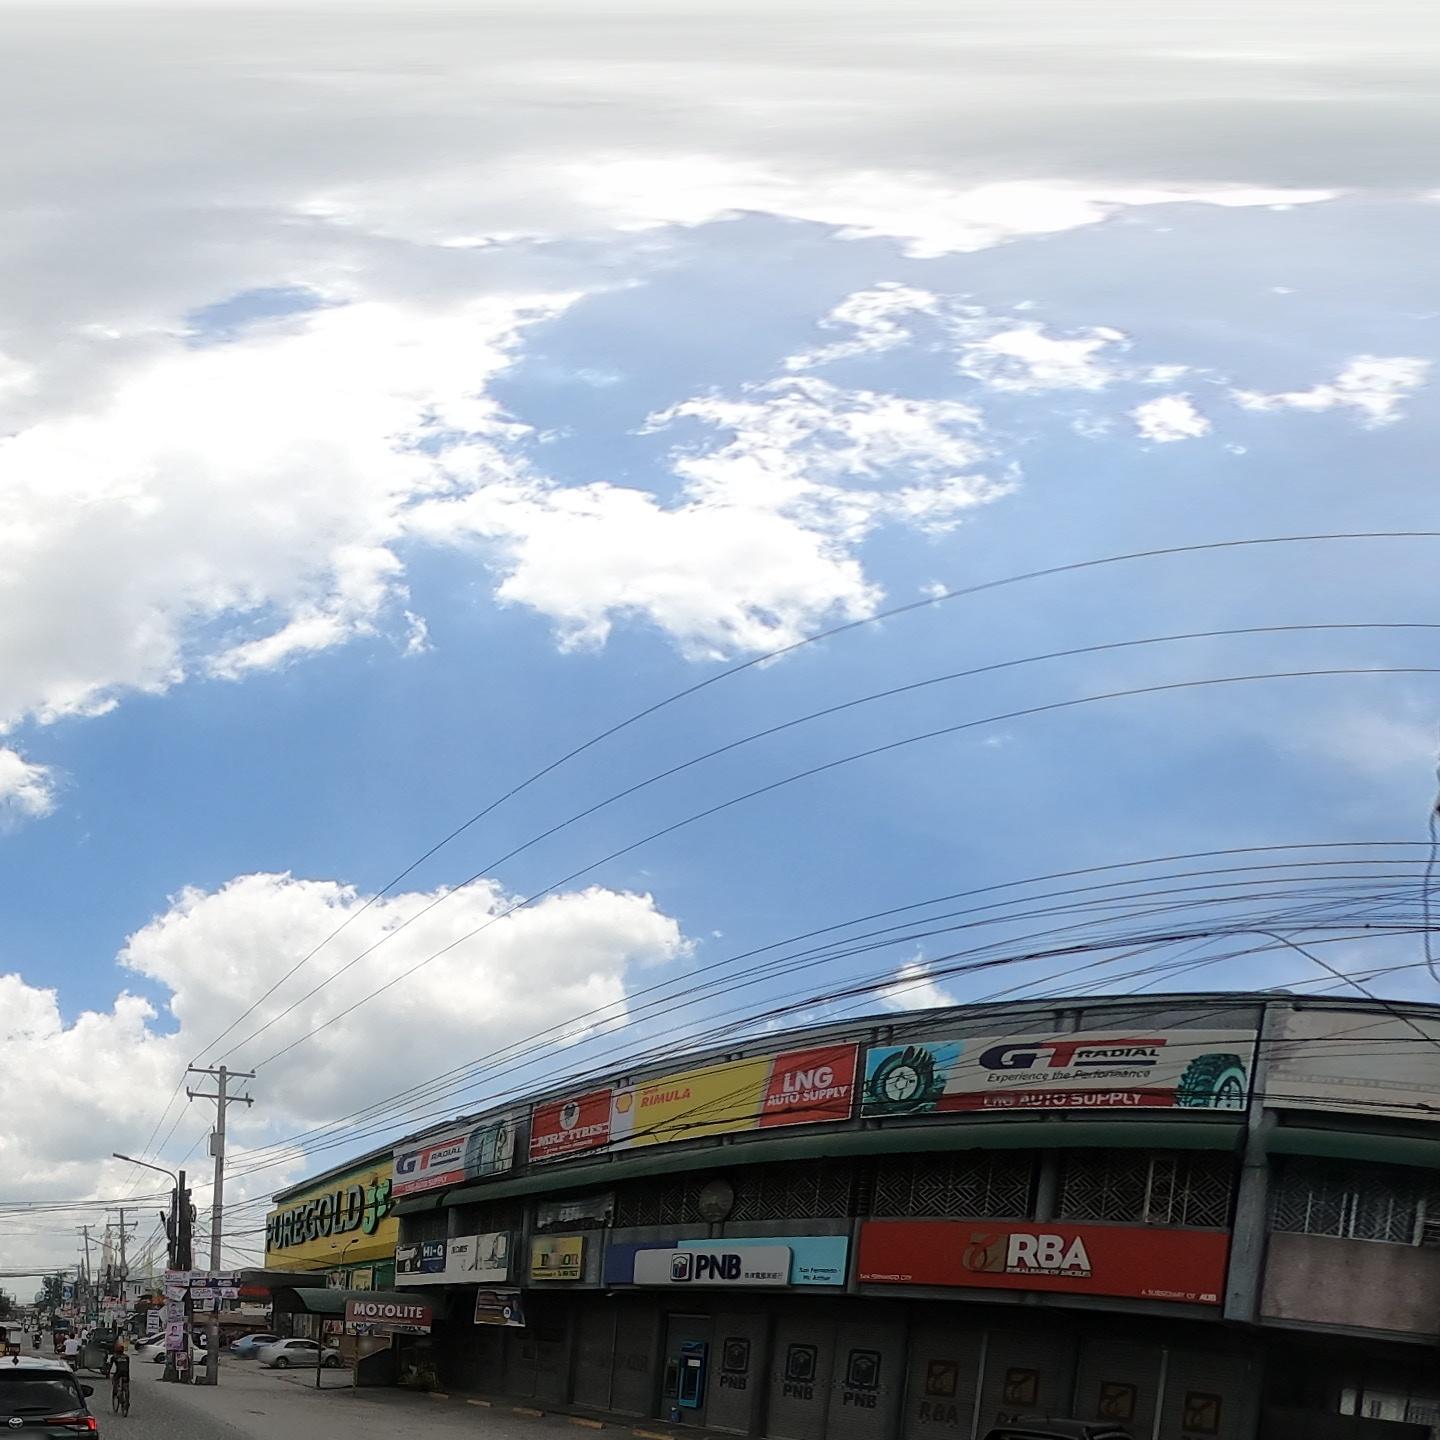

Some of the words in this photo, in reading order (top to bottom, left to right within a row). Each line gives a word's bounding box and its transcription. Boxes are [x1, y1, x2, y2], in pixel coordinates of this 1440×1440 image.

[1076, 1048, 1160, 1059] RADIAL
[783, 1066, 834, 1092] LNG
[987, 1070, 1049, 1083] Experience
[1052, 1070, 1071, 1080] the
[1071, 1068, 1151, 1081] Performance
[640, 1087, 694, 1109] RIMULA
[767, 1090, 801, 1106] AUTO
[802, 1085, 849, 1102] SUPPLY
[1020, 1093, 1067, 1106] AUTO
[1069, 1092, 1143, 1106] SUPPLY
[538, 1130, 567, 1147] MRF
[430, 1146, 463, 1161] RADIAL
[266, 1184, 365, 1252] PUREGOLD
[422, 1243, 444, 1258] HI-Q
[1006, 1233, 1092, 1271] RBA
[694, 1254, 742, 1281] PNB
[353, 1301, 424, 1320] MOTOLITE
[719, 1375, 747, 1390] PNB
[783, 1383, 813, 1400] PNB
[842, 1391, 877, 1409] PNB
